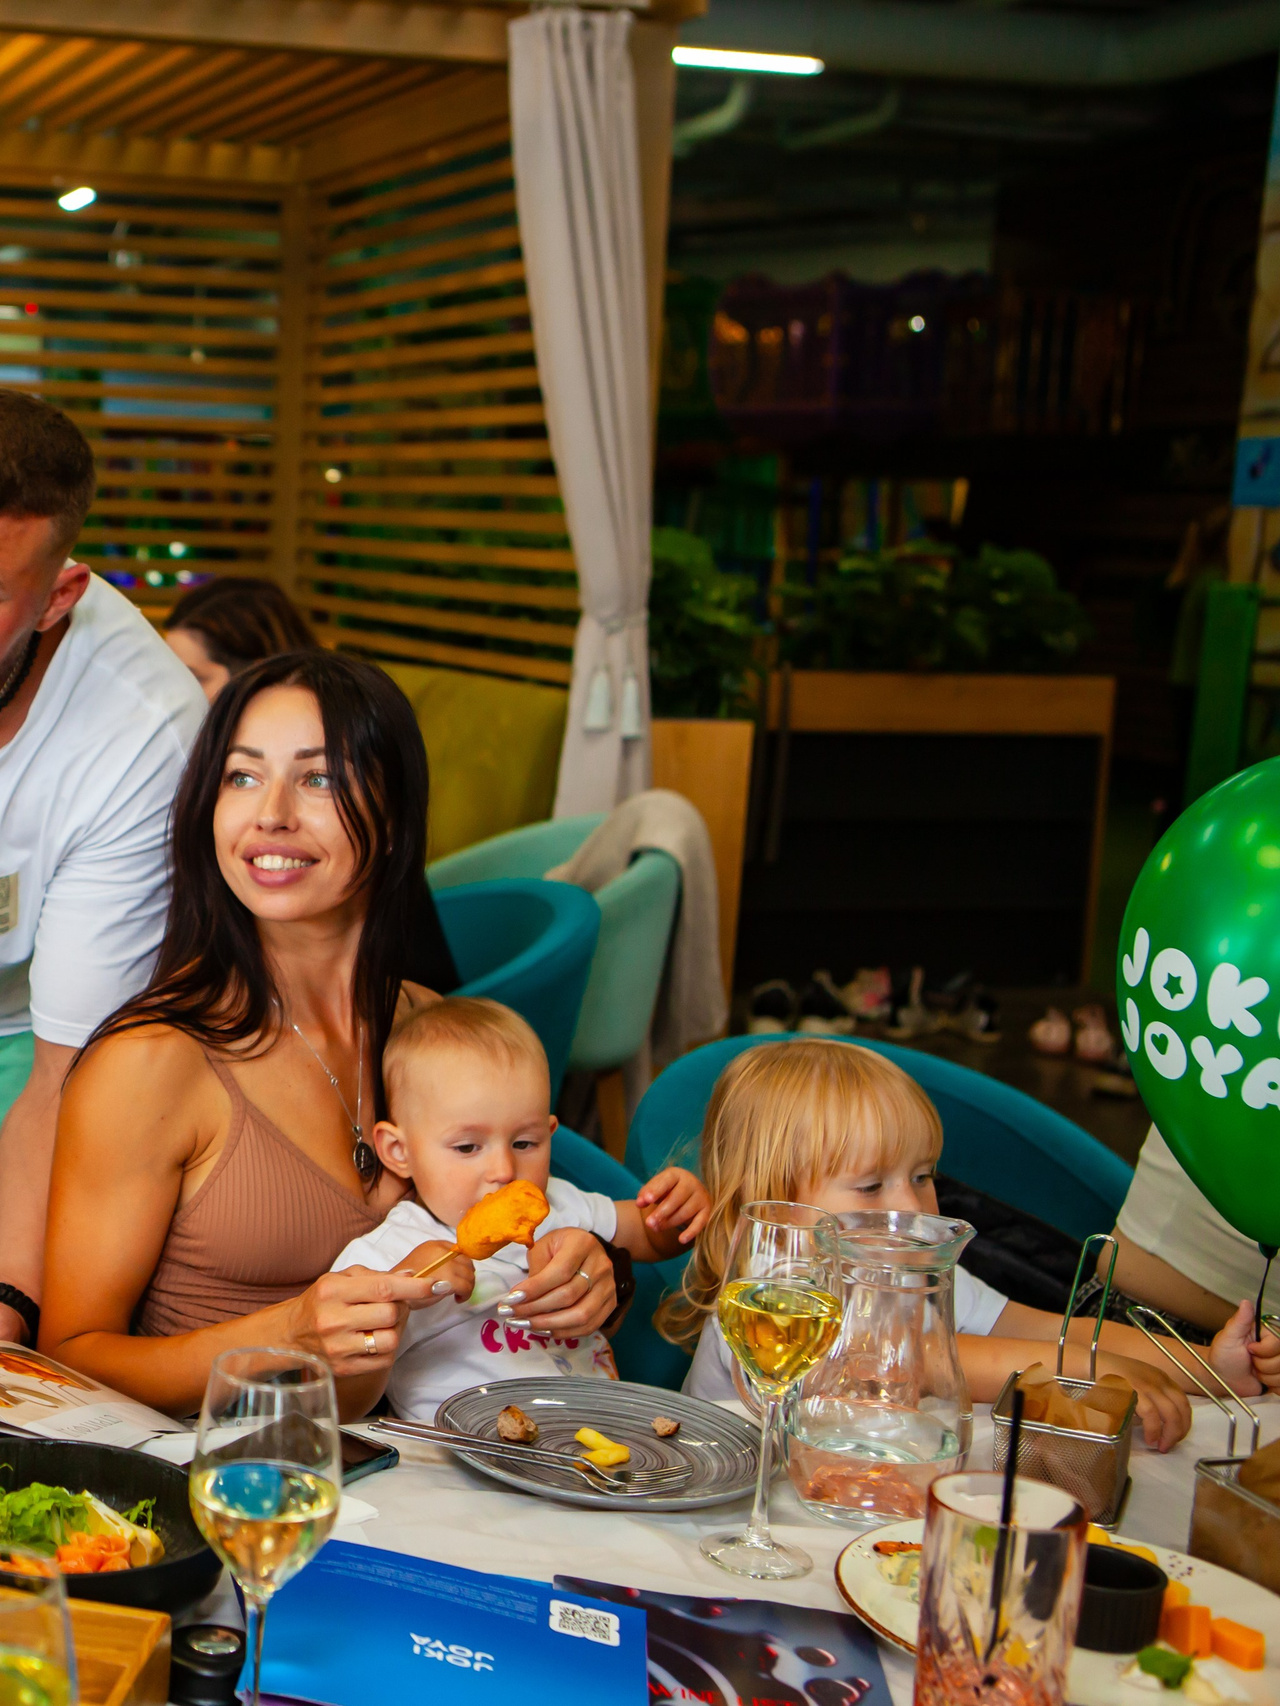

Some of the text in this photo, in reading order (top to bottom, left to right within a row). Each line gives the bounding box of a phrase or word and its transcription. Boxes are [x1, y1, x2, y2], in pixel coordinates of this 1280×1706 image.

[1122, 926, 1280, 1040] JOK
[409, 1632, 495, 1661] JOYA
[412, 1643, 494, 1672] JOKI
